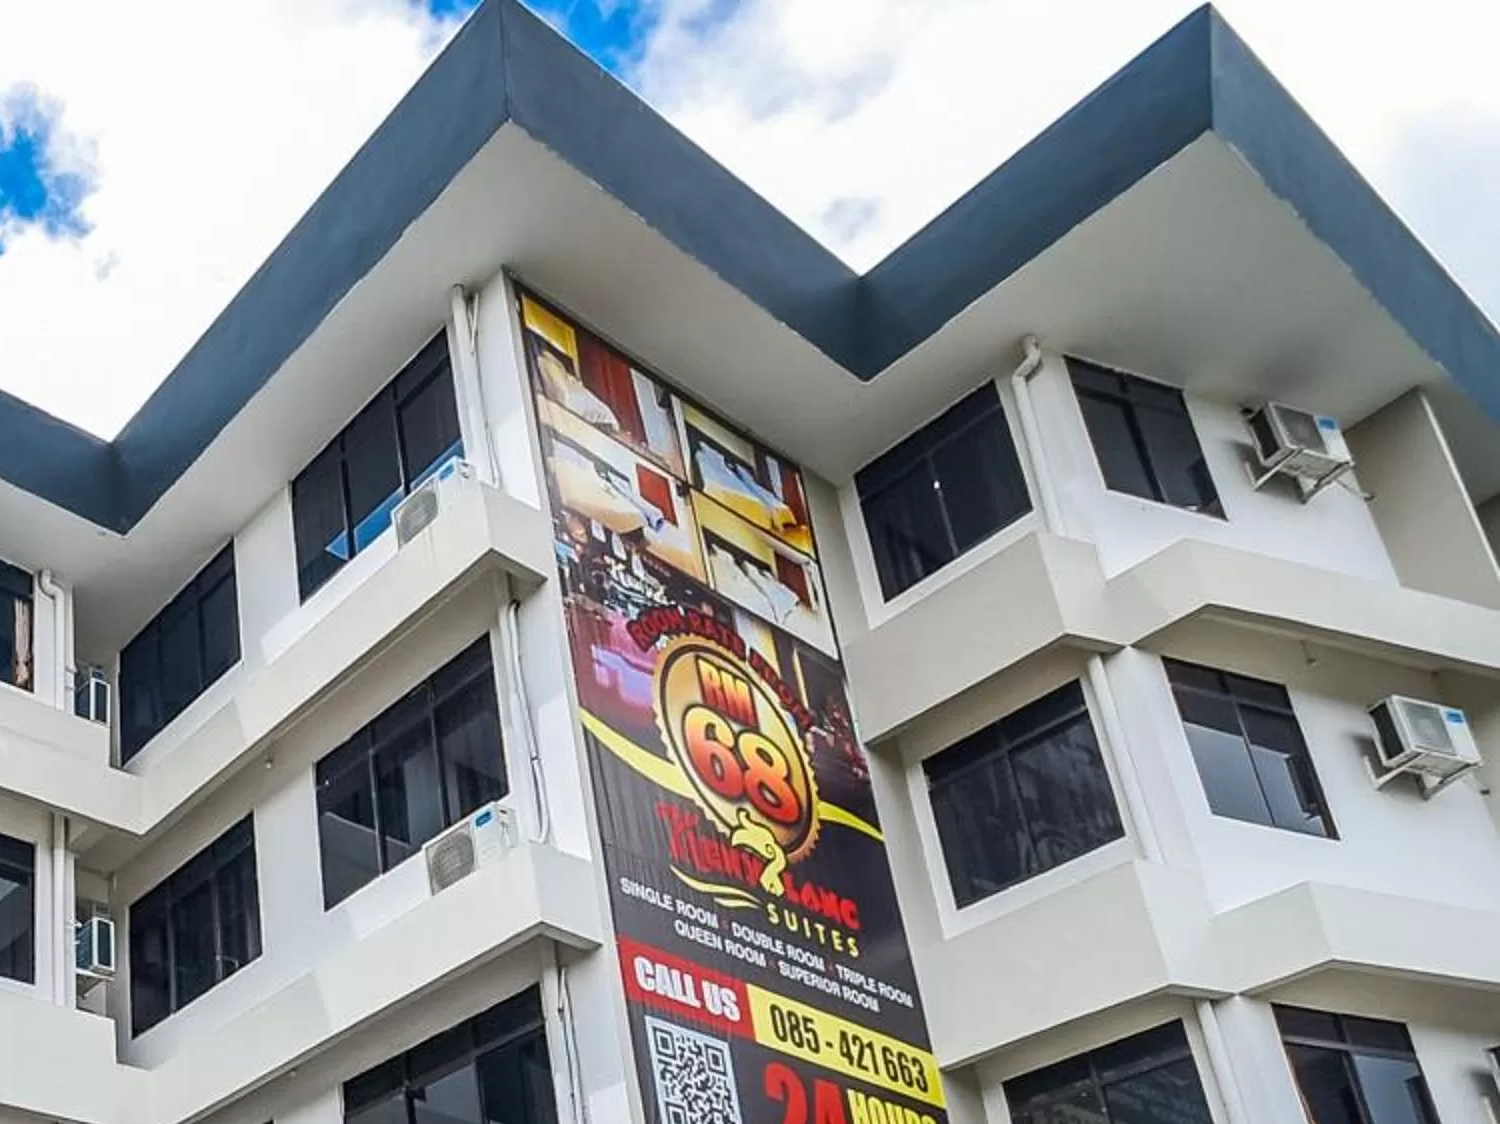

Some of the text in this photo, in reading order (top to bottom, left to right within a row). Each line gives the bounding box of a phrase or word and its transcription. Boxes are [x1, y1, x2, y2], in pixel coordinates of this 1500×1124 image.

[627, 605, 684, 652] ROOM
[696, 655, 758, 728] RM
[682, 704, 802, 825] 68
[620, 877, 914, 1009] SINGLE ROOM DOUBLE ROOM TRIPLE ROOM
[767, 903, 860, 959] SUITES
[634, 957, 741, 1022] CALL US
[674, 920, 881, 1013] QUEEN ROOM SUPERIOR ROOM
[769, 1003, 820, 1055] 085
